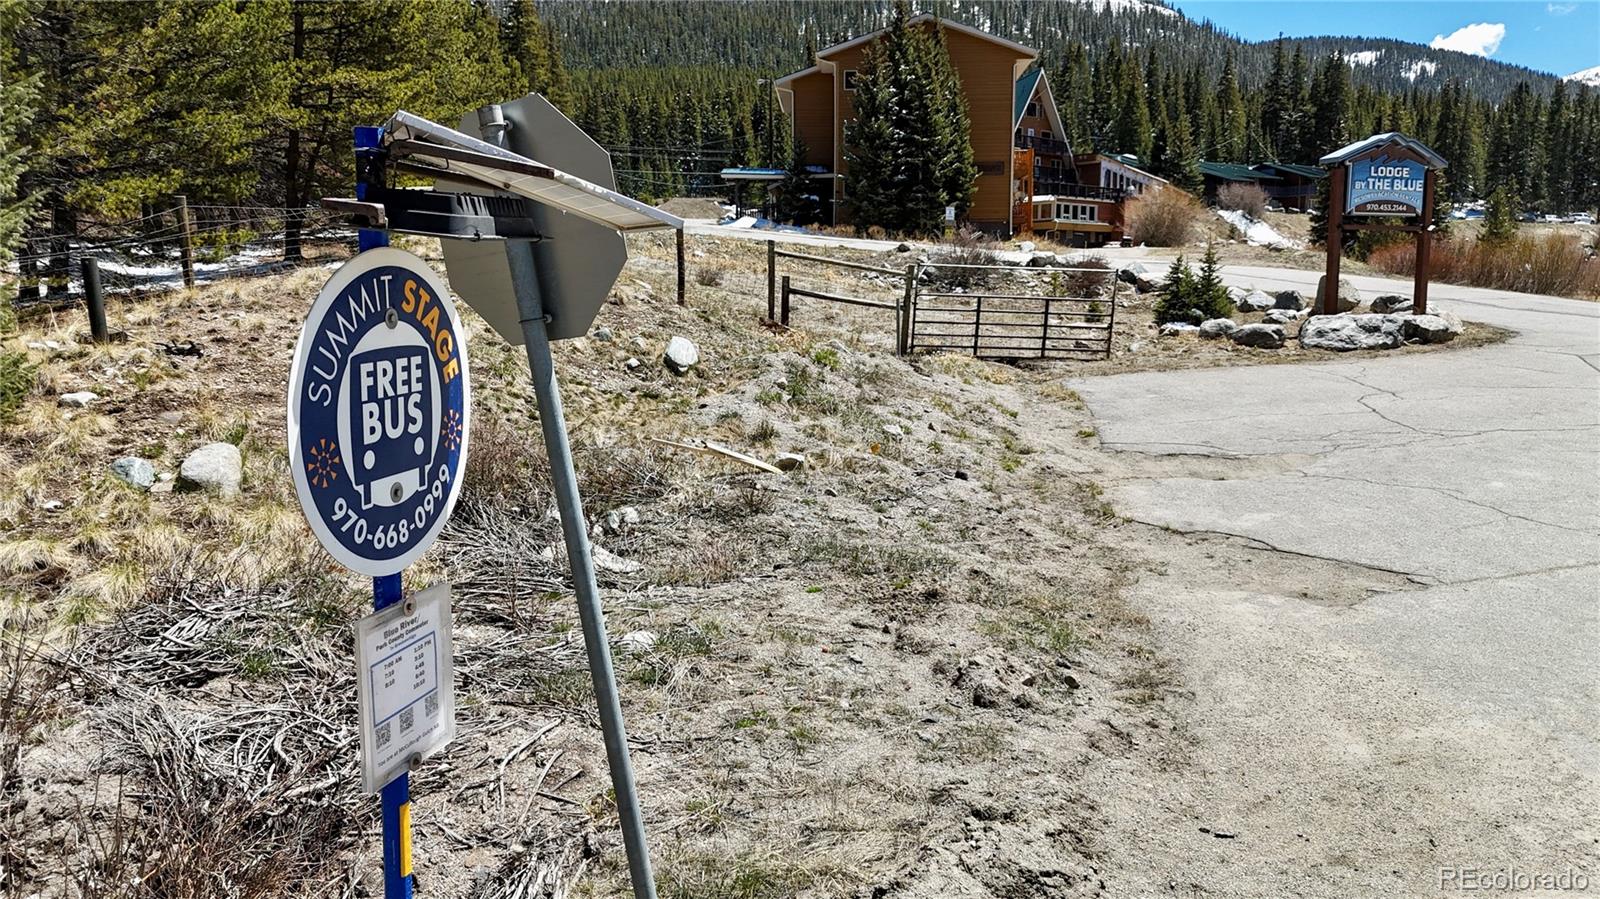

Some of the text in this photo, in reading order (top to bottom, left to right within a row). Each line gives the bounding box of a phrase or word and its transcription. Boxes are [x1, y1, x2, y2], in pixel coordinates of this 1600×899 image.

[1355, 178, 1424, 192] BY THE BLUE
[1371, 166, 1410, 178] LODGE
[1366, 203, 1407, 212] 970.453.2144
[308, 275, 459, 407] SUMMIT STAGE
[360, 355, 423, 401] FREE
[362, 393, 423, 445] BUS
[331, 463, 450, 550] 970-668-0999
[375, 620, 429, 652] Park County Commuter
[383, 626, 399, 639] Blue
